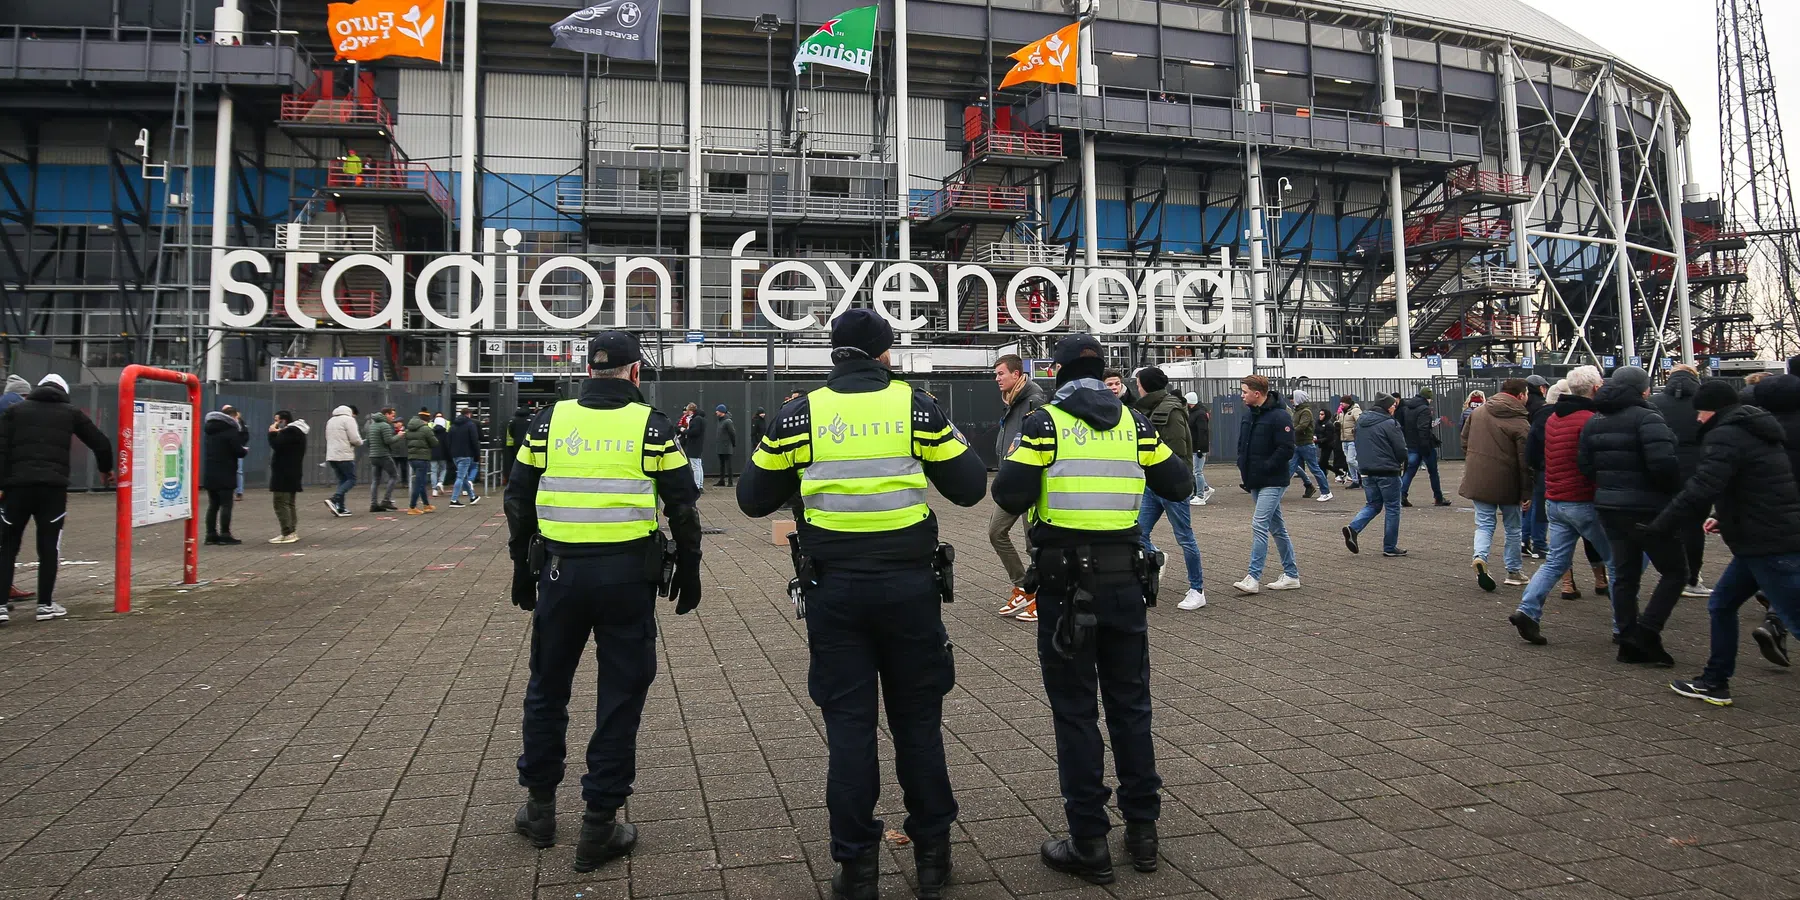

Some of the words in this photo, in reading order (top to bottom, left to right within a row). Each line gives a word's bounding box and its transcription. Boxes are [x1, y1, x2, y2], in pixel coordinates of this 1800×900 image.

[217, 223, 671, 330] stadion
[730, 229, 1233, 334] feyenoord
[488, 343, 500, 352] 42
[546, 344, 557, 352] 43
[575, 344, 586, 352] 44
[1428, 358, 1438, 366] 45
[332, 366, 356, 380] NN
